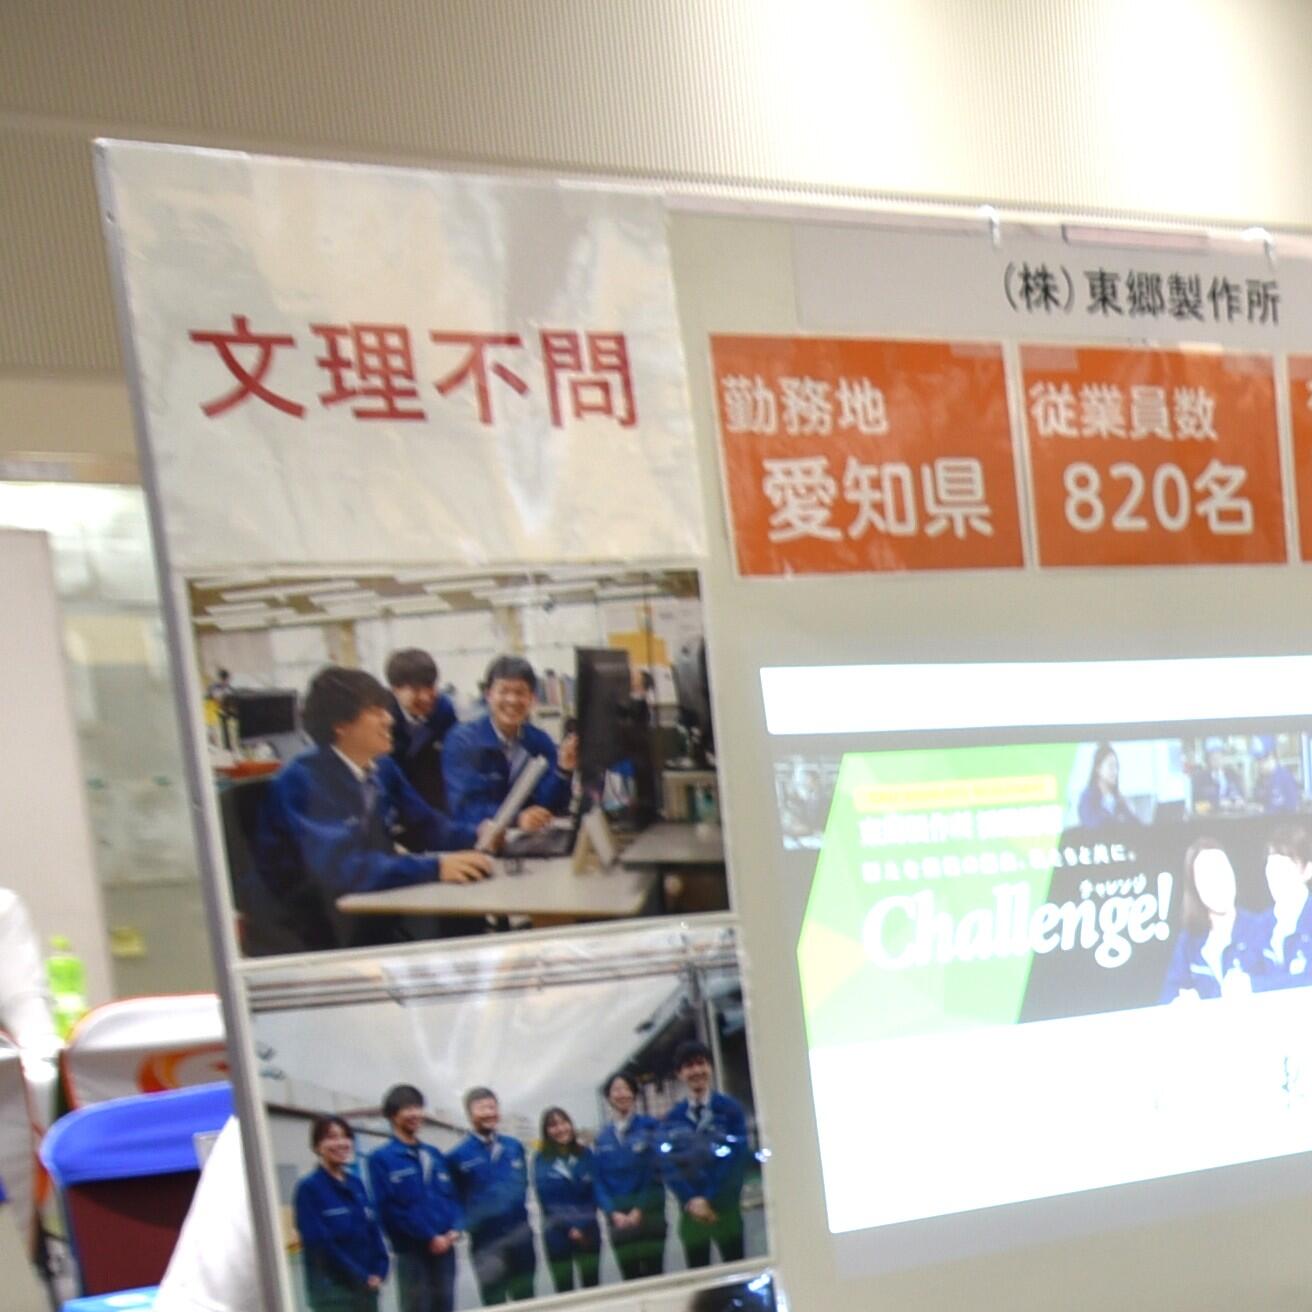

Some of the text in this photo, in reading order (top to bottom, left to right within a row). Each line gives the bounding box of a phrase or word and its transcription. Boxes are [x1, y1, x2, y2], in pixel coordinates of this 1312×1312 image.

[189, 314, 638, 429] 文理不問
[722, 376, 889, 438] 勤務地
[1030, 382, 1217, 441] 従業員数
[763, 457, 995, 542] 愛知県
[1063, 462, 1254, 536] 820名
[862, 872, 1173, 969] Challenge!
